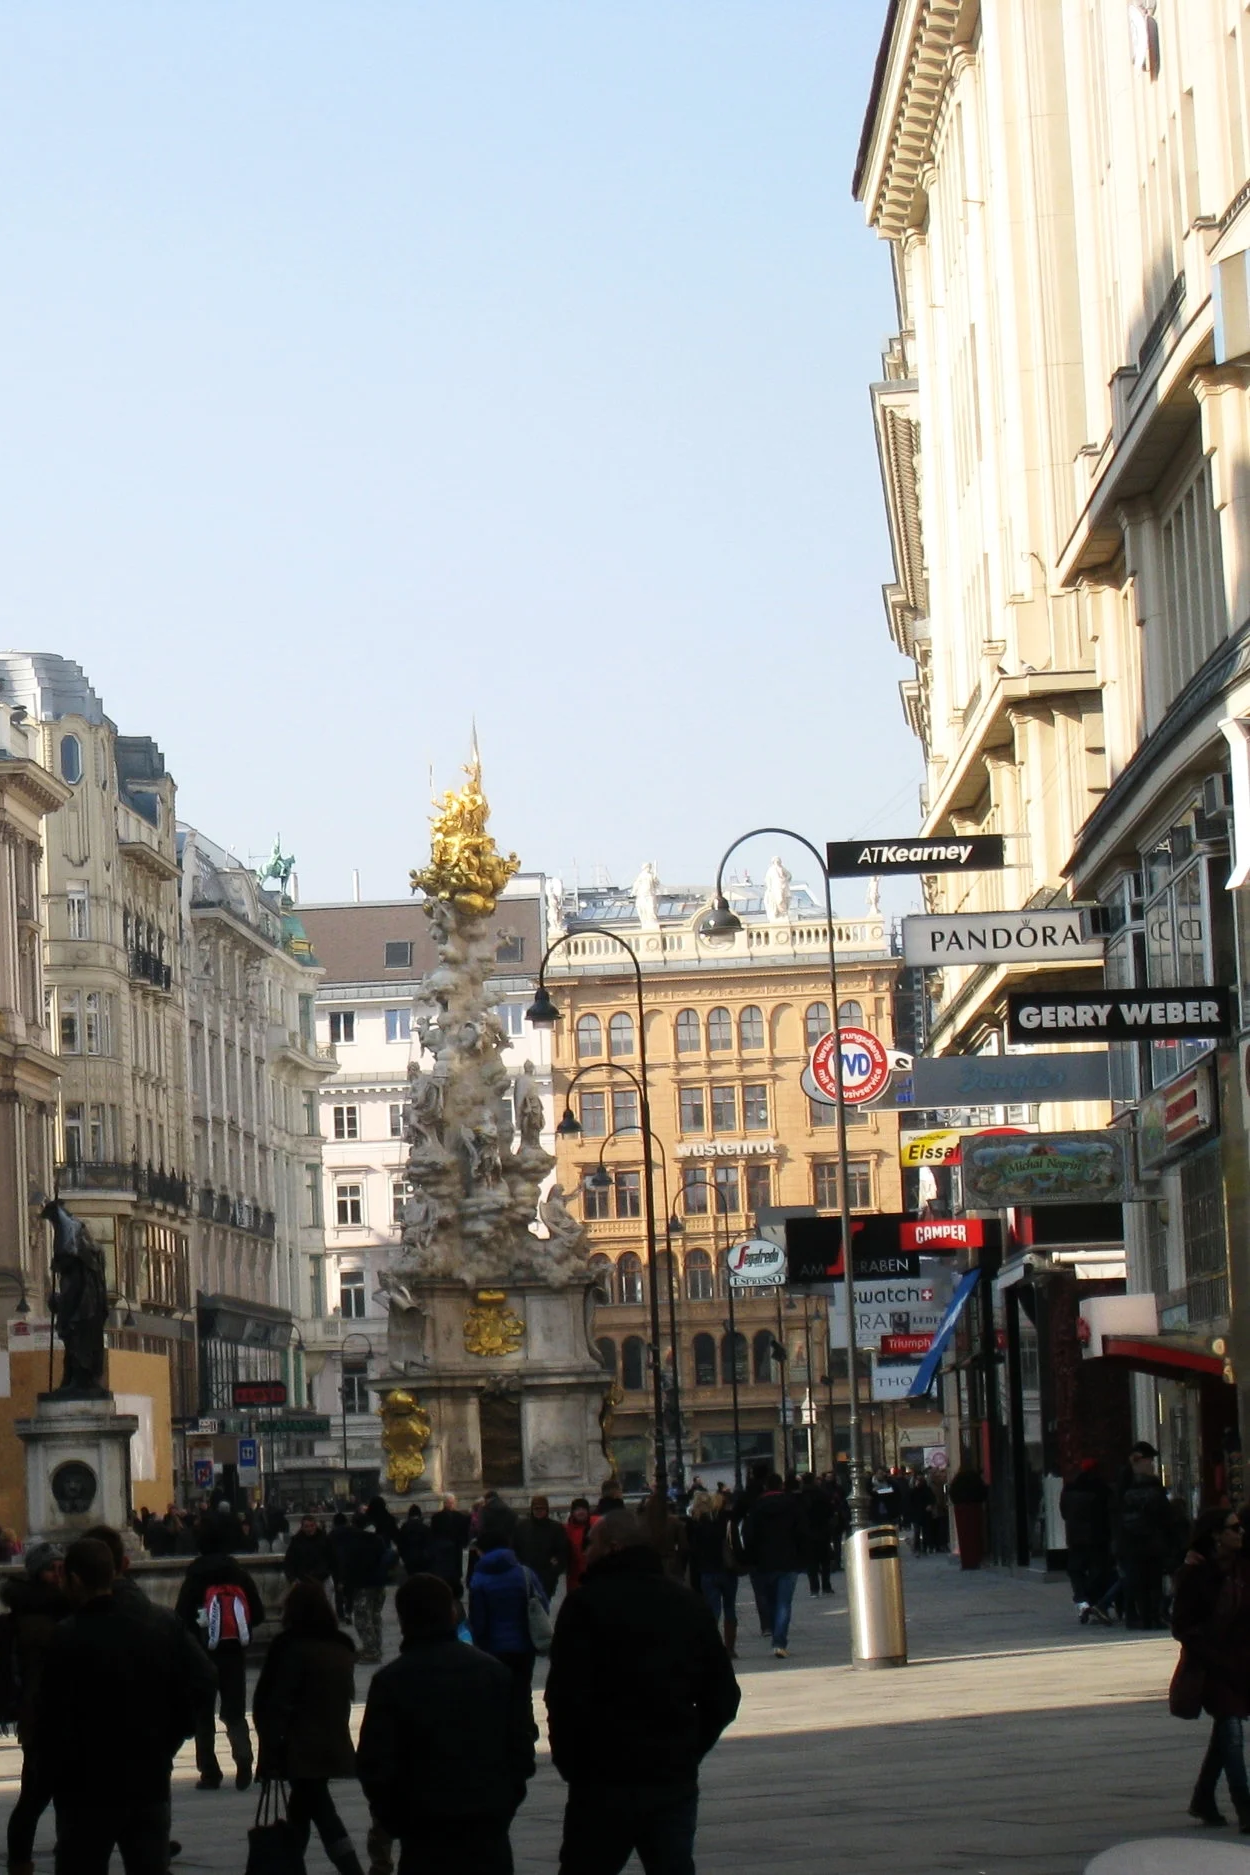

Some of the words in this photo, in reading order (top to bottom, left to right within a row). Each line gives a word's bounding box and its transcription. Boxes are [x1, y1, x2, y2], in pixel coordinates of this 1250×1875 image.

[931, 924, 1081, 952] PANDORA
[1018, 1004, 1112, 1029] GERRY
[1119, 1001, 1221, 1026] WEBER
[816, 1032, 884, 1064] Versicrungsdienst
[915, 1224, 967, 1244] CAMPER
[799, 1264, 824, 1276] AM
[732, 1275, 782, 1286] ESPRESSO
[888, 1338, 931, 1351] Triumph
